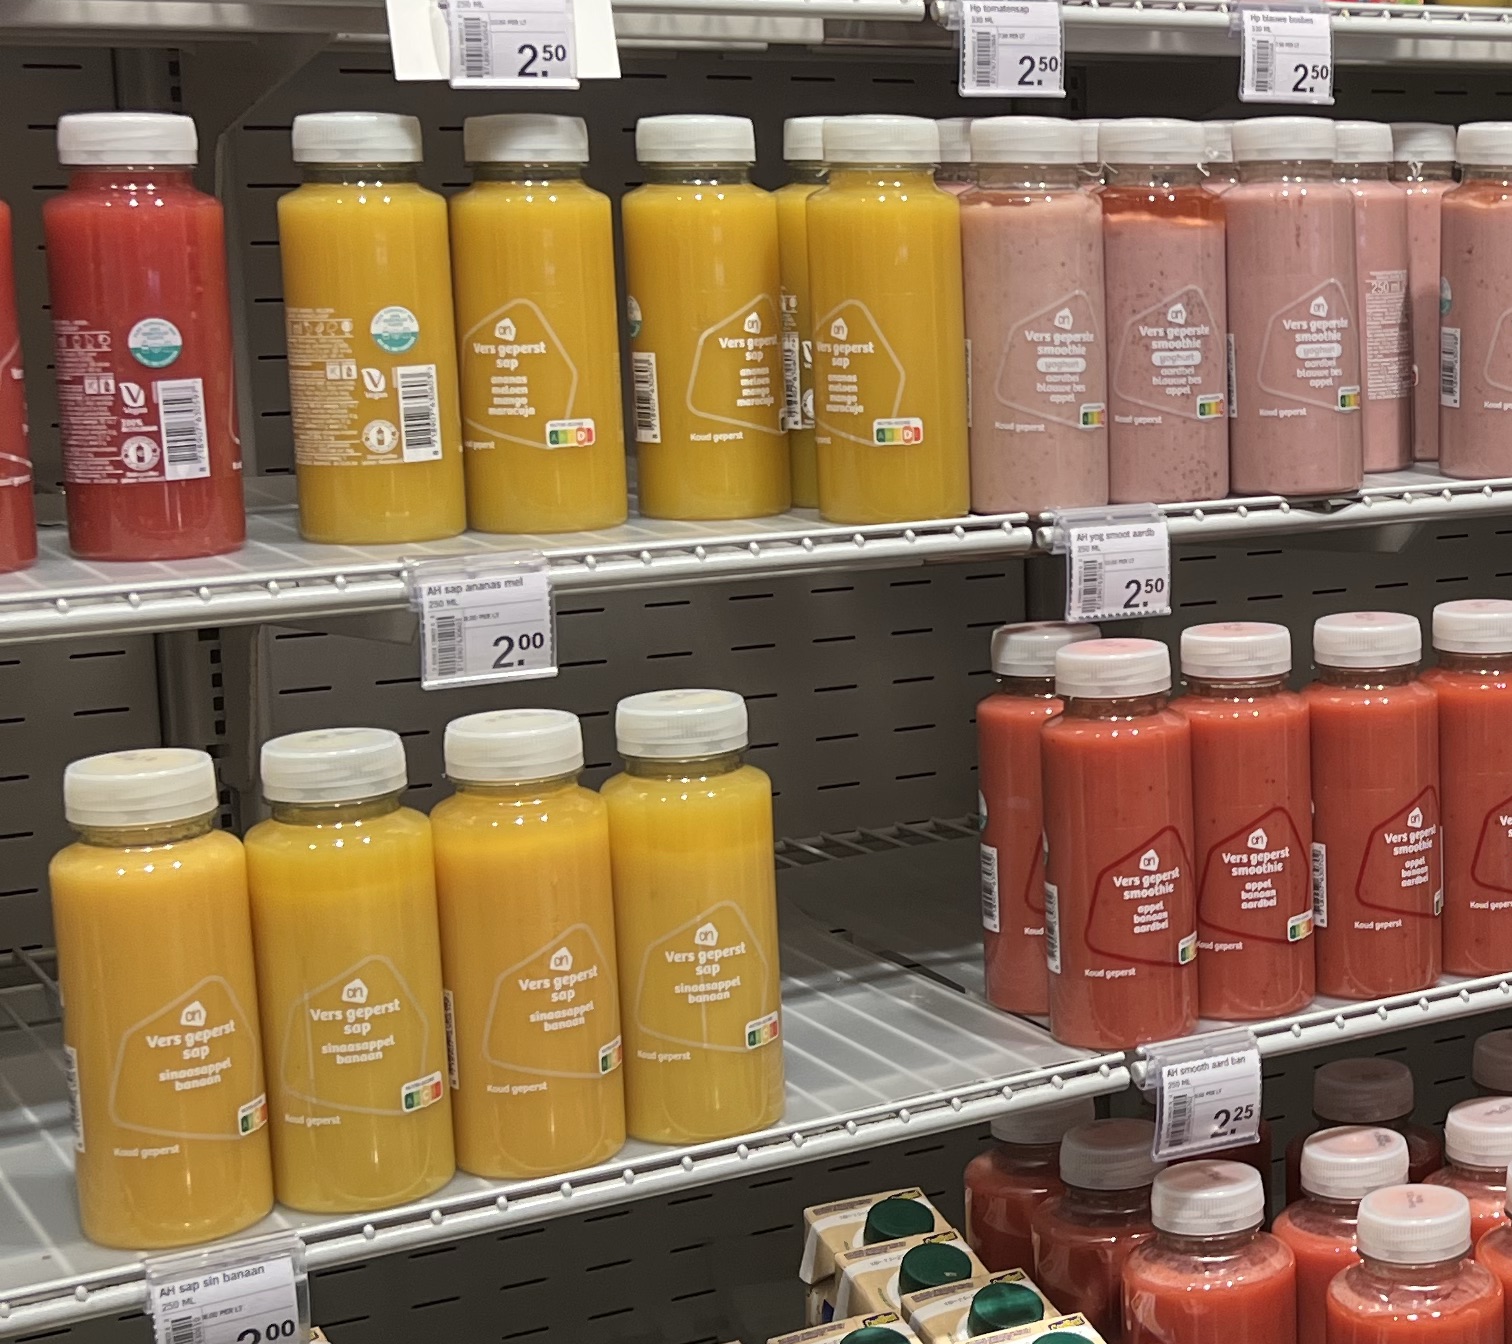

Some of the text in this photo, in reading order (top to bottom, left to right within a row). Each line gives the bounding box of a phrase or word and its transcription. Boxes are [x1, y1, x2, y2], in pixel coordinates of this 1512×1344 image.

[517, 43, 566, 77] 2.50
[1017, 55, 1058, 86] 2.50
[1292, 64, 1329, 93] 2.50
[427, 586, 441, 596] AH
[445, 586, 463, 594] sap
[466, 581, 501, 592] ananas
[1123, 578, 1164, 609] 2.50
[492, 632, 544, 669] 2.00
[145, 1020, 236, 1048] Vers geperst
[182, 1045, 210, 1061] sap
[159, 1057, 232, 1081] sinaasappel
[174, 1073, 221, 1091] banaan
[1167, 1069, 1178, 1077] AH
[1210, 1103, 1254, 1138] 2.25
[159, 1265, 265, 1298] AH sap sin banaan
